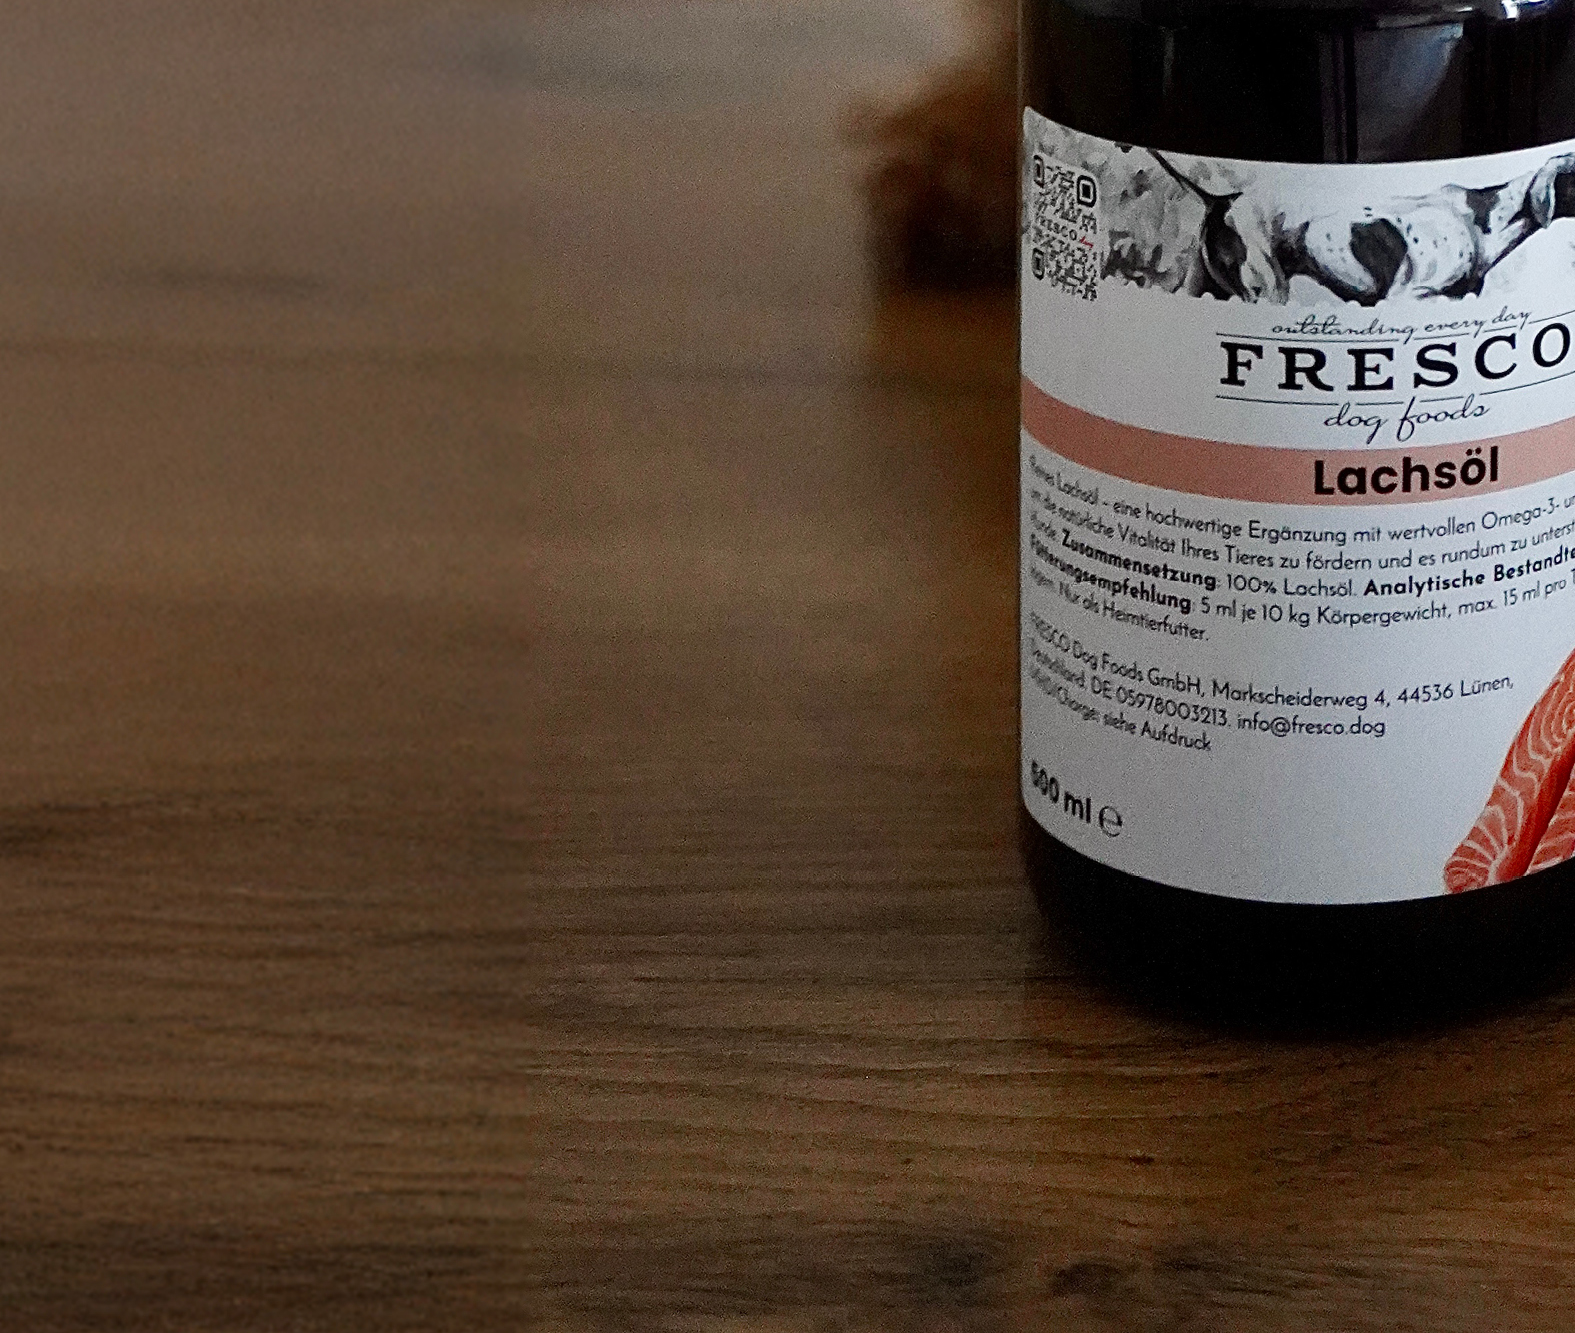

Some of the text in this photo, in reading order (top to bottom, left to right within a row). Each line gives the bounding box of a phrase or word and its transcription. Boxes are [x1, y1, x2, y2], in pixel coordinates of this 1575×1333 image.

[1271, 305, 1531, 344] outstanding every day
[1220, 322, 1572, 392] FRESCO
[1323, 393, 1490, 444] dog foods
[1313, 446, 1499, 496] Lachsöl
[1112, 499, 1141, 519] eine
[1145, 501, 1242, 540] hochwertige
[1247, 519, 1347, 547] Ergänzung
[1353, 527, 1381, 543] mit
[1387, 515, 1476, 542] wertvollen
[1481, 497, 1560, 530] Omega-3-
[1117, 521, 1176, 554] Vitalität
[1181, 537, 1220, 562] Ihres
[1224, 544, 1274, 568] Tieres
[1280, 555, 1300, 569] zu
[1306, 550, 1372, 571] fördern
[1378, 548, 1413, 570] und
[1418, 553, 1436, 567] es
[1441, 540, 1506, 565] rundum
[1510, 538, 1528, 552] zu
[1201, 595, 1212, 614] 5
[1216, 598, 1237, 618] ml
[1240, 603, 1257, 624] je
[1262, 603, 1283, 622] 10
[1288, 602, 1311, 628] kg
[1316, 599, 1452, 628] Körpergewicht,
[1502, 587, 1519, 607] 15
[1521, 579, 1541, 602] ml
[1544, 579, 1567, 600] pro
[1227, 573, 1278, 594] 100%
[1363, 569, 1486, 598] Analytische
[1090, 674, 1113, 701] DE
[1236, 710, 1387, 738] info@fresco.dog
[1101, 650, 1145, 682] Foods
[1147, 667, 1206, 698] GmbH,
[1211, 678, 1369, 712] Markscheiderweg
[1374, 688, 1391, 708] 4,
[1397, 682, 1455, 705] 44536
[1460, 675, 1515, 698] Lünen,
[1140, 719, 1212, 752] Aufdruck
[1063, 789, 1092, 824] ml
